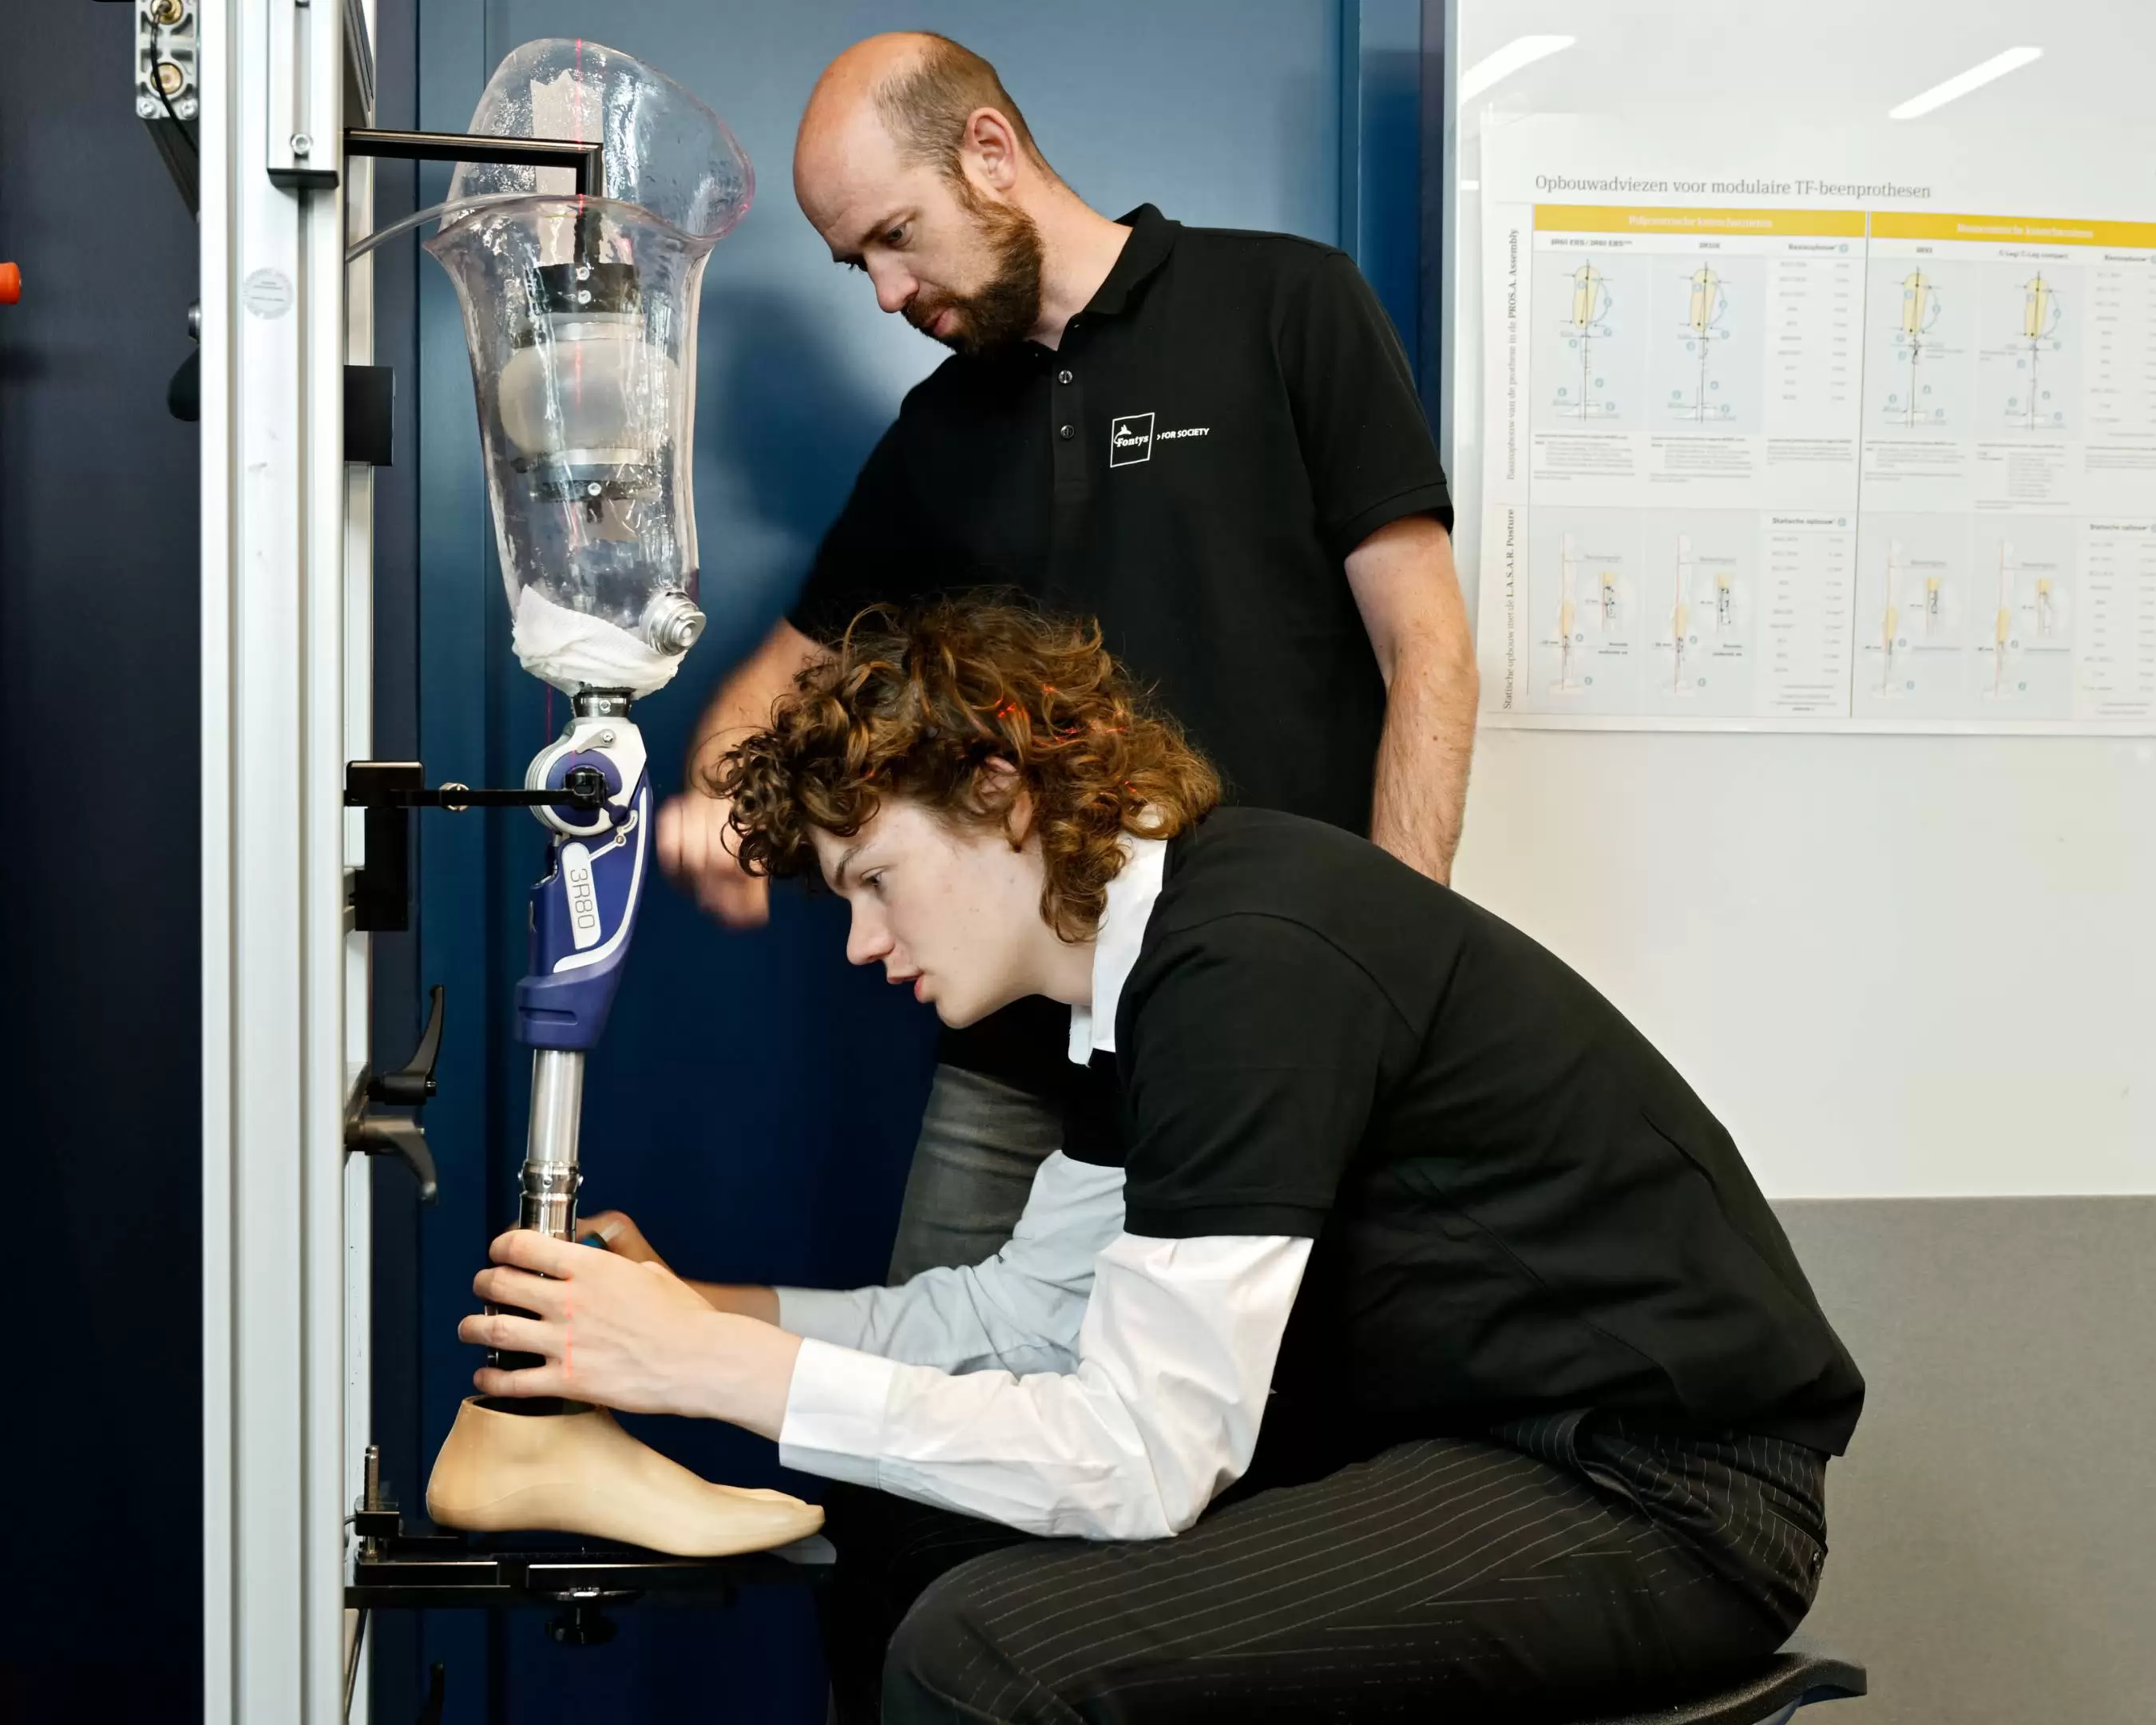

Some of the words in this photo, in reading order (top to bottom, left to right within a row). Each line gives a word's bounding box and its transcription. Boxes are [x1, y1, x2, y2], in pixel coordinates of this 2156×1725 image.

[1536, 175, 1668, 193] Opbouwadviezen
[1673, 180, 1706, 193] voor
[1711, 179, 1791, 194] modulaire
[1795, 180, 1931, 200] TF-beenprothesen
[1508, 229, 1519, 276] Assembly
[1508, 280, 1517, 319] PROS.A.
[1508, 321, 1516, 332] de
[1508, 335, 1516, 343] in
[1508, 347, 1517, 385] prothese
[1508, 387, 1516, 399] de
[1508, 401, 1516, 418] van
[1116, 435, 1149, 447] Fontys
[1161, 430, 1176, 440] FOR
[1177, 427, 1210, 438] SOCIETY
[1507, 421, 1517, 480] Basisopbouw
[1505, 600, 1514, 611] de
[1506, 632, 1516, 668] opbouw
[1504, 668, 1514, 710] Statische
[570, 868, 596, 929] 3R80
